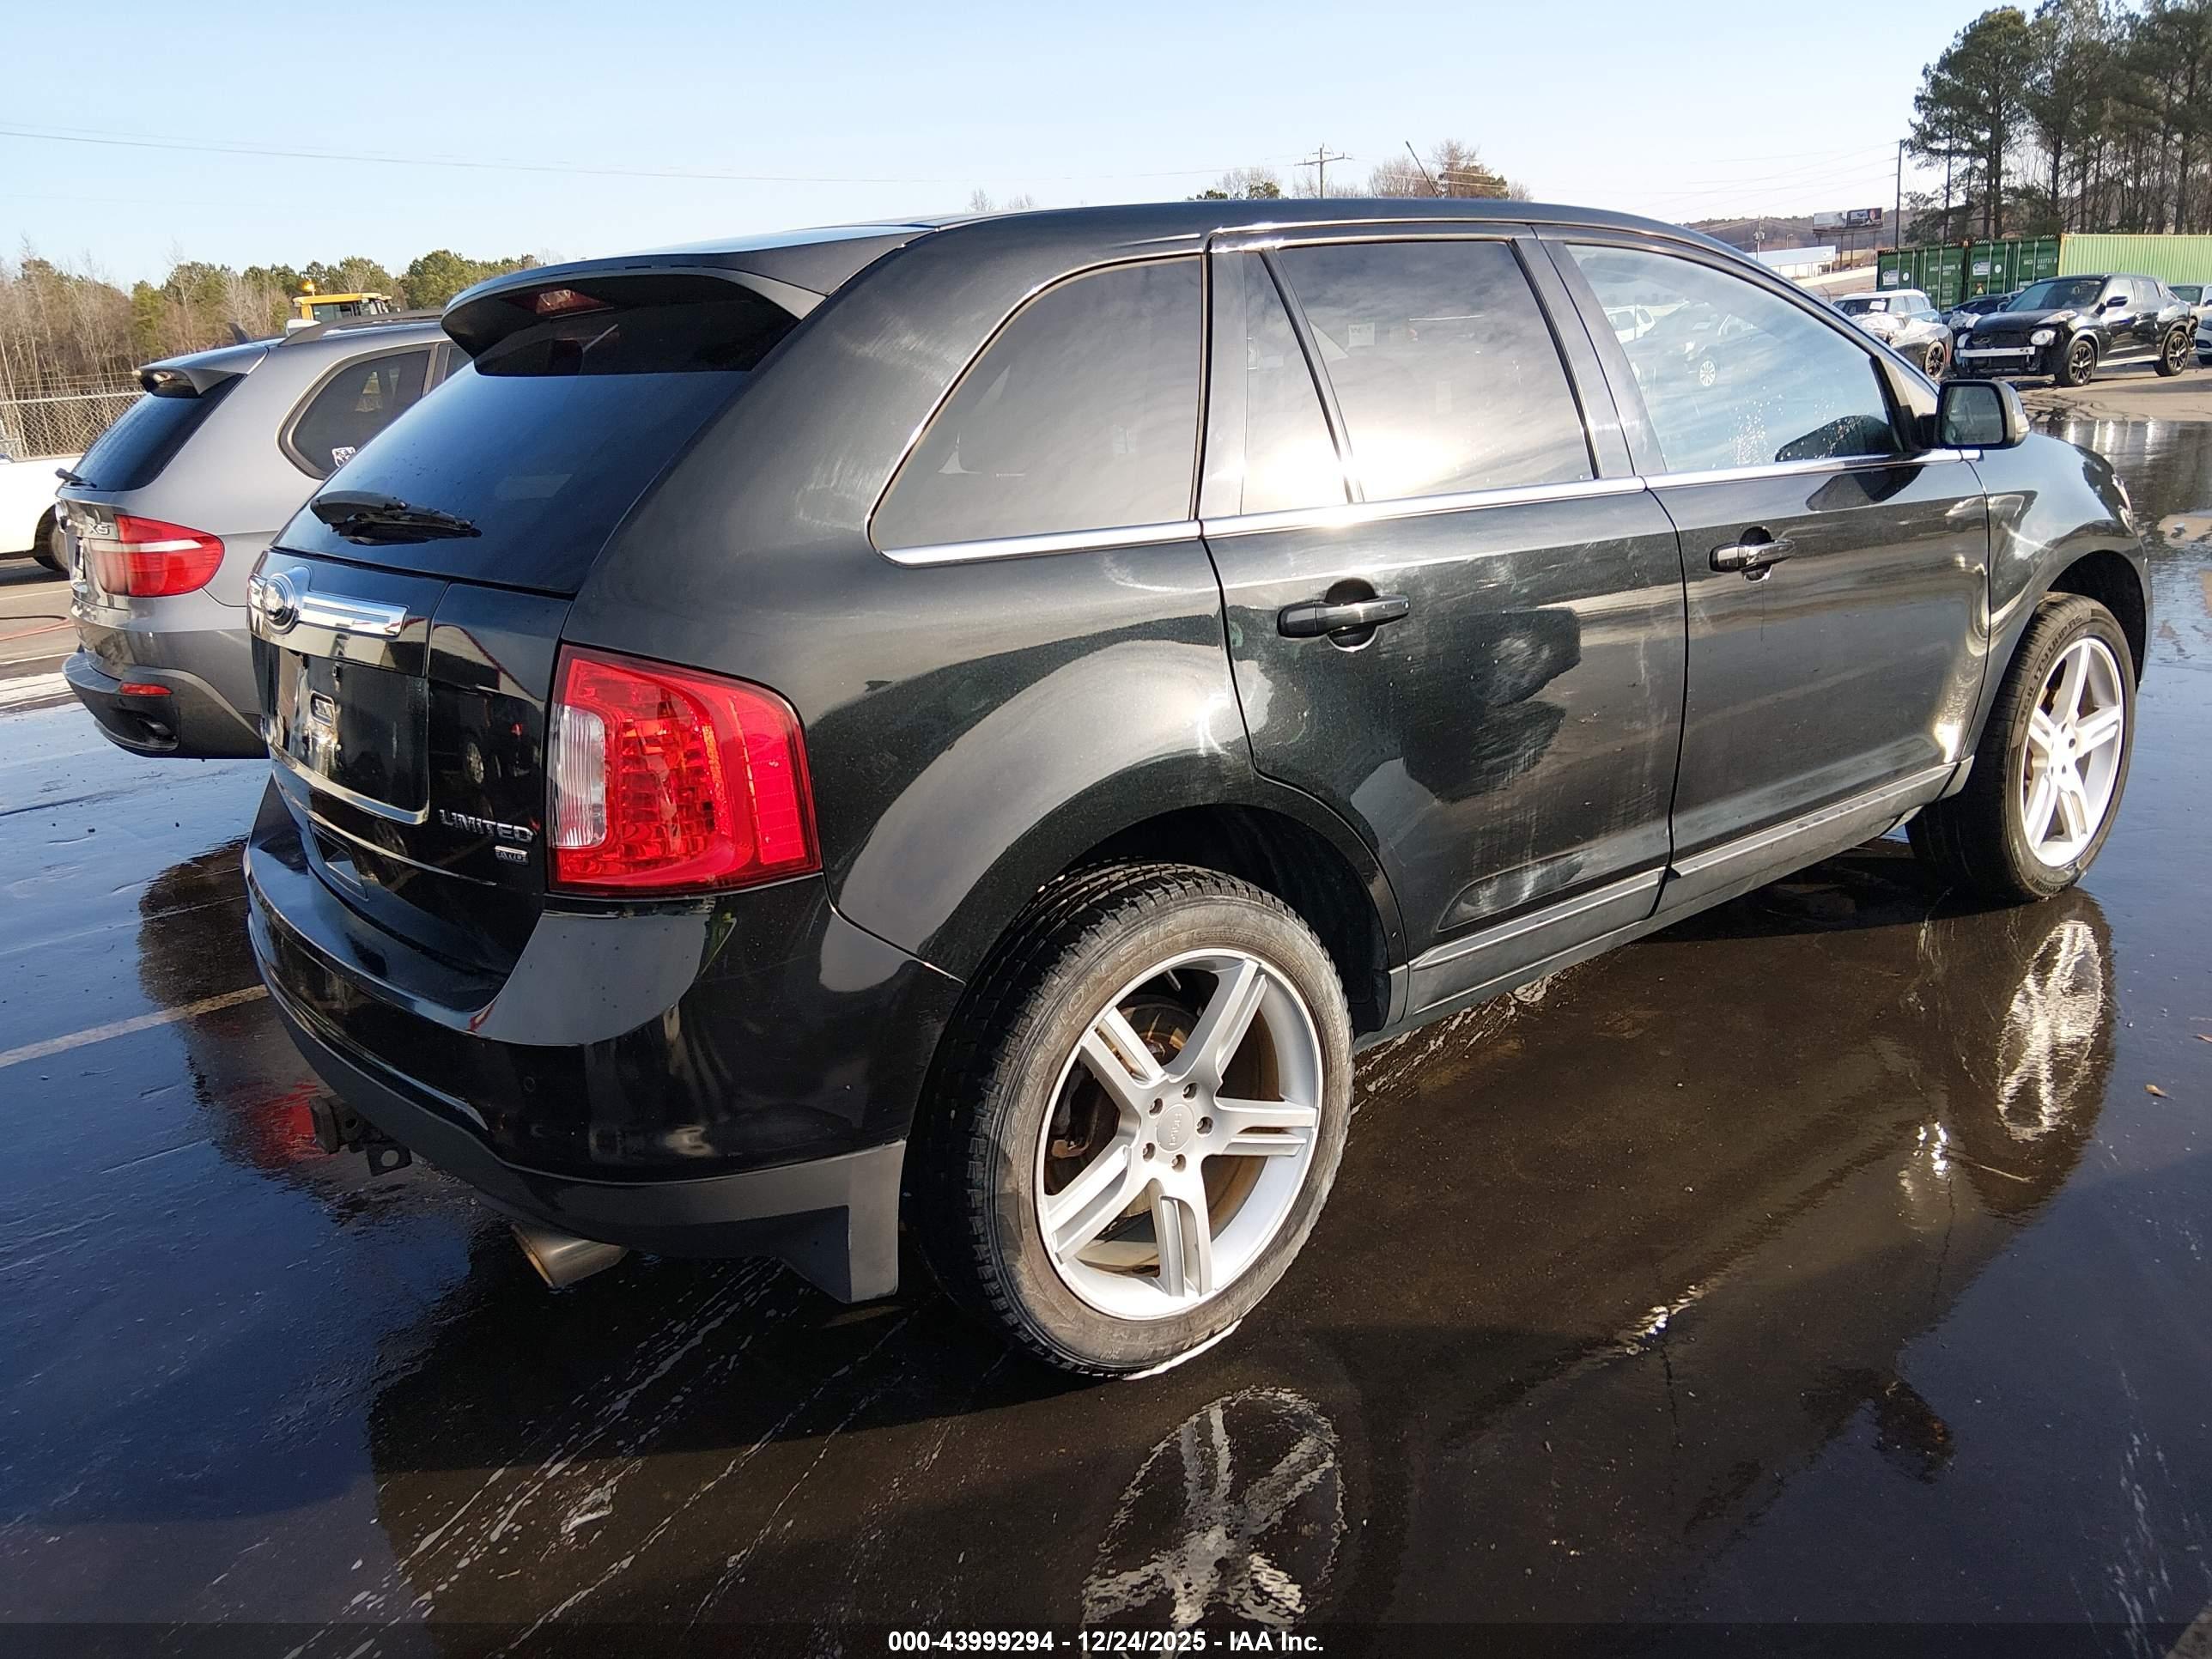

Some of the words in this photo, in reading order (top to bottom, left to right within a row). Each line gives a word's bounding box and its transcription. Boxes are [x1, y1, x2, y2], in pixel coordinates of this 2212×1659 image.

[88, 521, 112, 535] X5
[439, 809, 534, 843] LIMITED
[495, 847, 528, 864] AWD
[1004, 962, 1107, 1163] SCORPION
